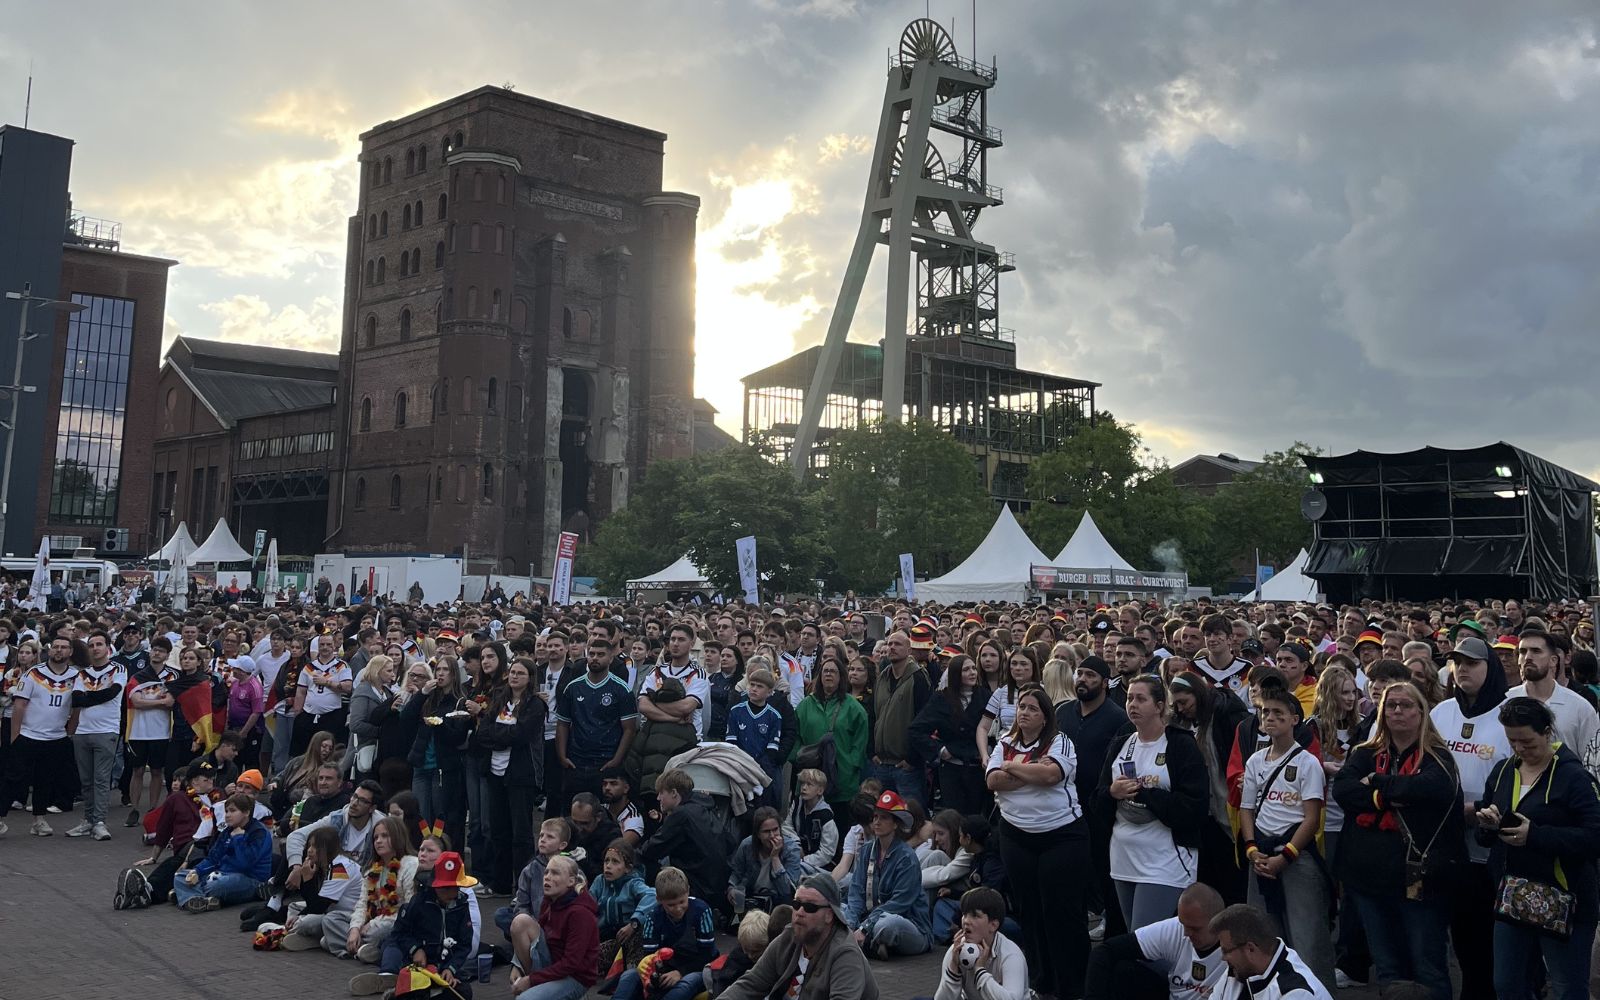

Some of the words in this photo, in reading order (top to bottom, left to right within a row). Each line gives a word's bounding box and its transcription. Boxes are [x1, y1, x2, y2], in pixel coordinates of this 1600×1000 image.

[1058, 573, 1087, 584] BURGER
[1093, 574, 1111, 584] FRIES
[1115, 575, 1136, 586] BRAT-
[1142, 576, 1185, 588] CURRYWURST
[49, 694, 63, 707] 10
[1445, 740, 1496, 760] HECK24
